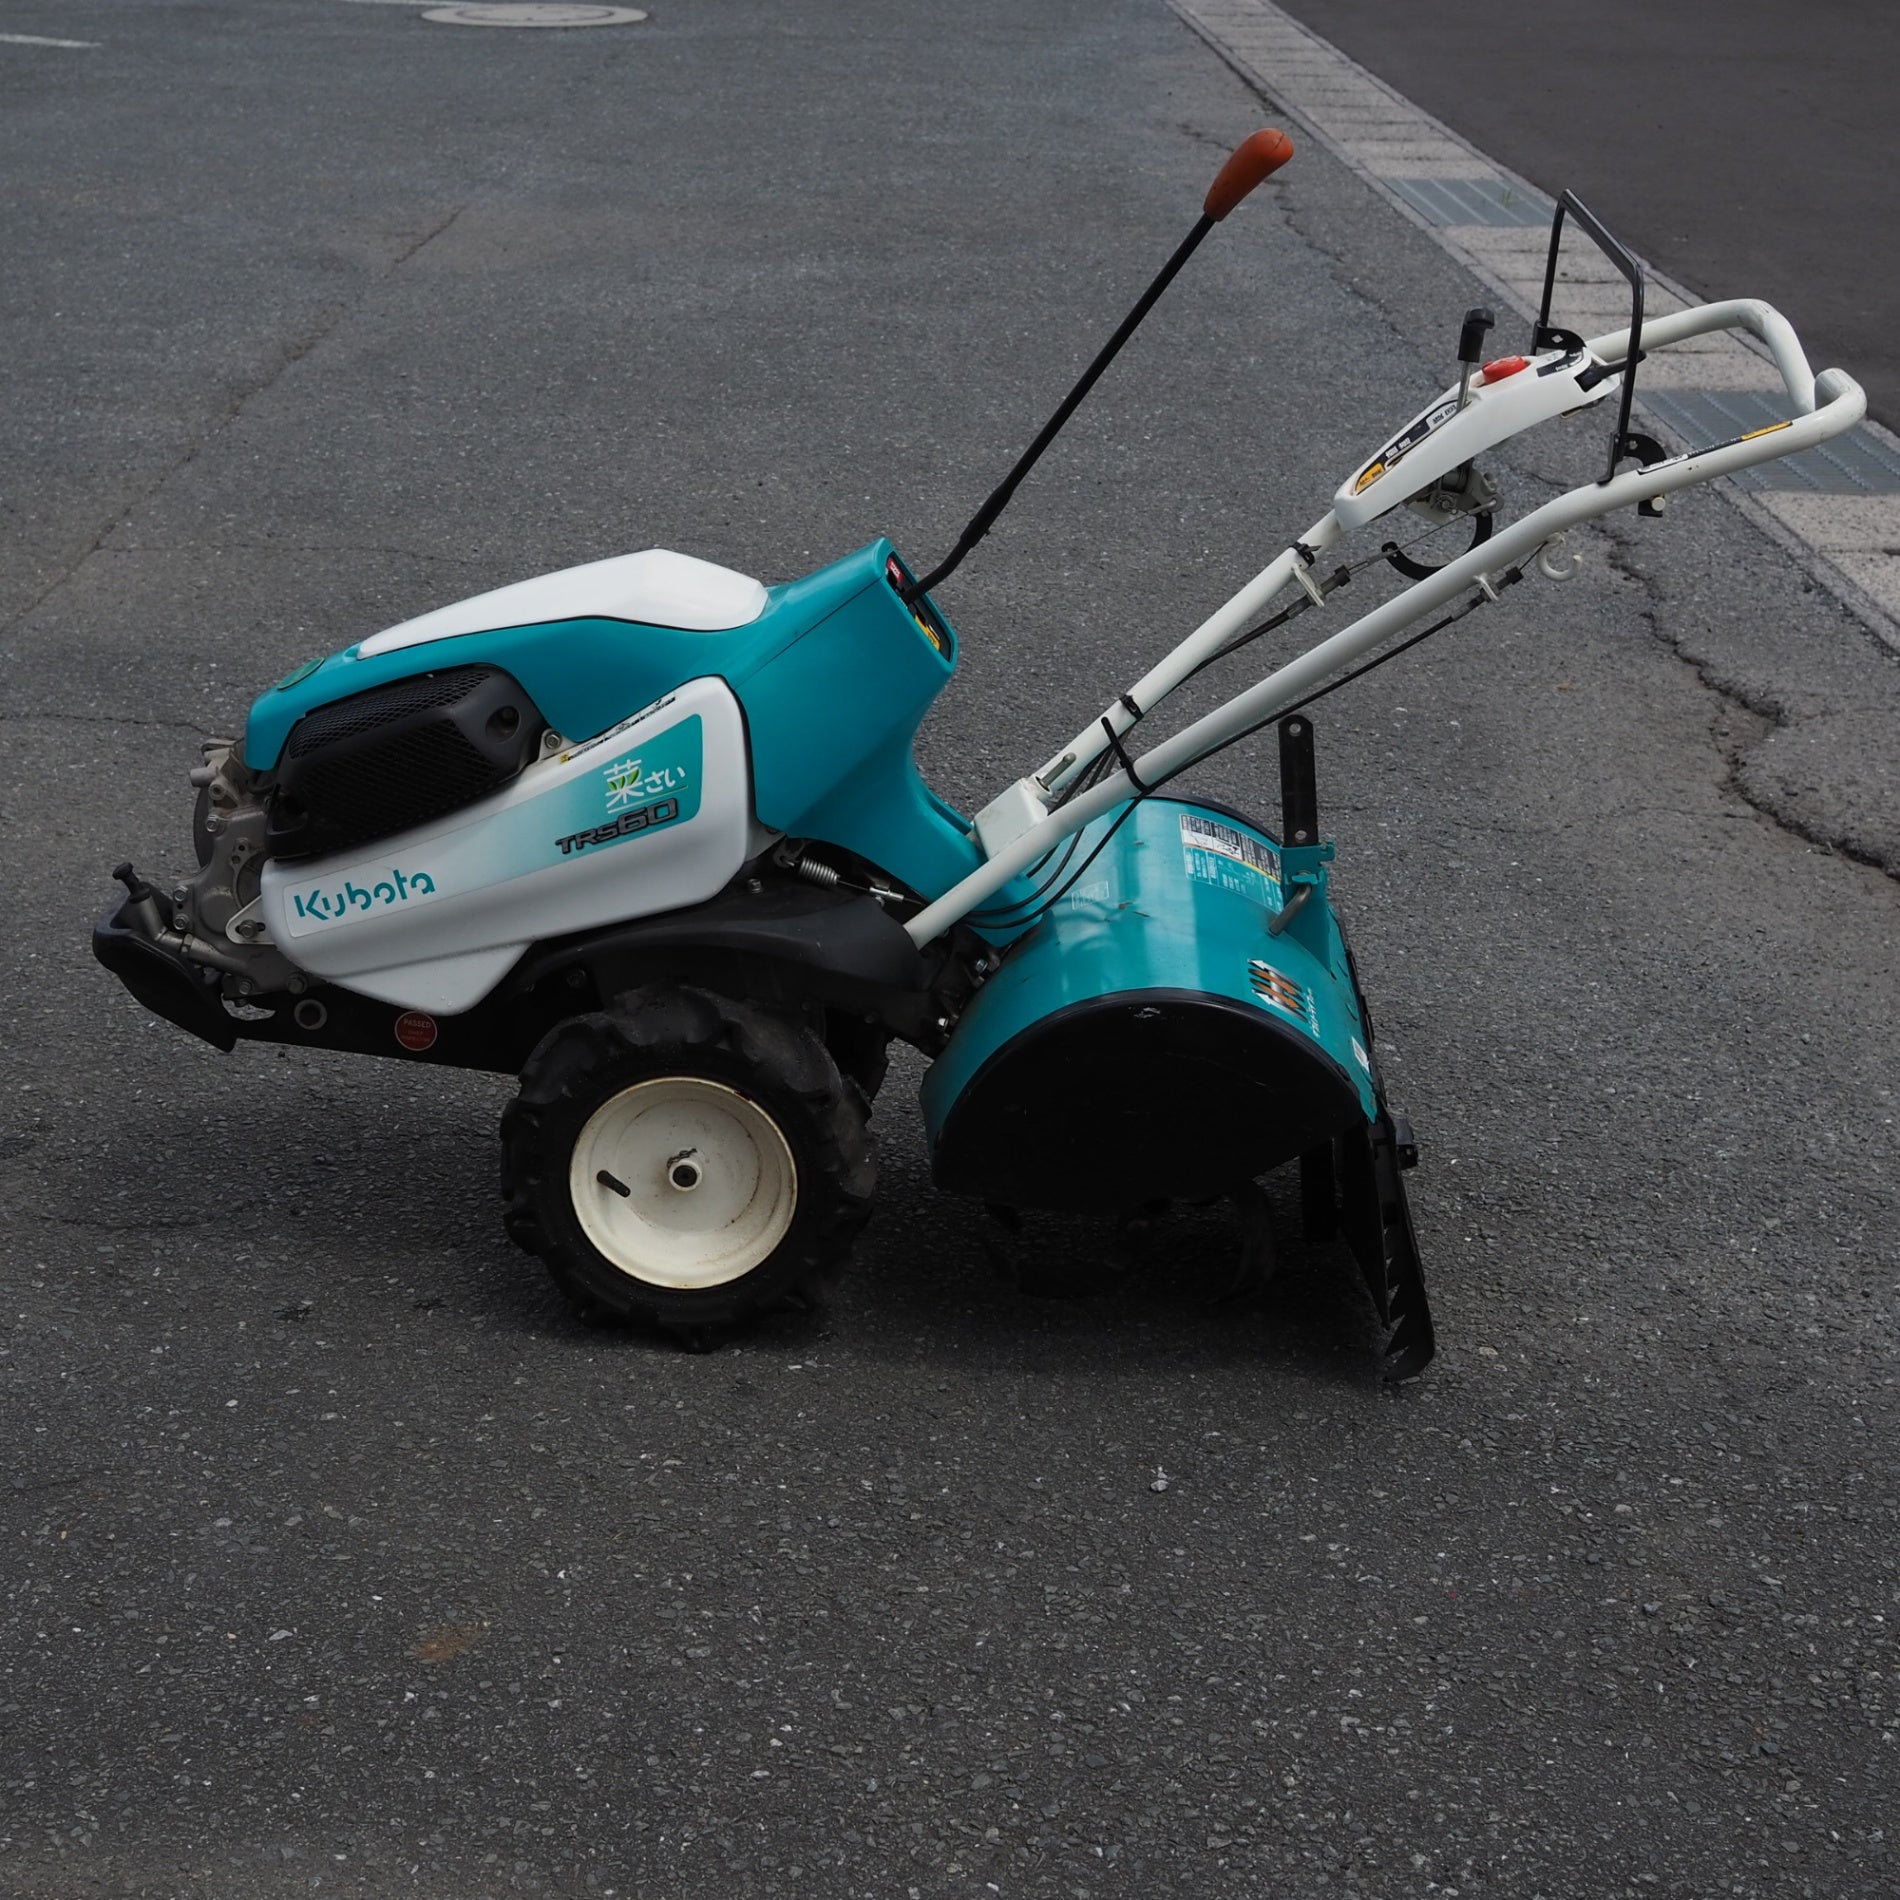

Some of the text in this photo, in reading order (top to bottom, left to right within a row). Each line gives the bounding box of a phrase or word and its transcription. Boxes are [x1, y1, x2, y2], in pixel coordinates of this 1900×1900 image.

[603, 759, 686, 808] 菜さい
[555, 798, 678, 854] TRS60
[294, 869, 435, 920] Kubota
